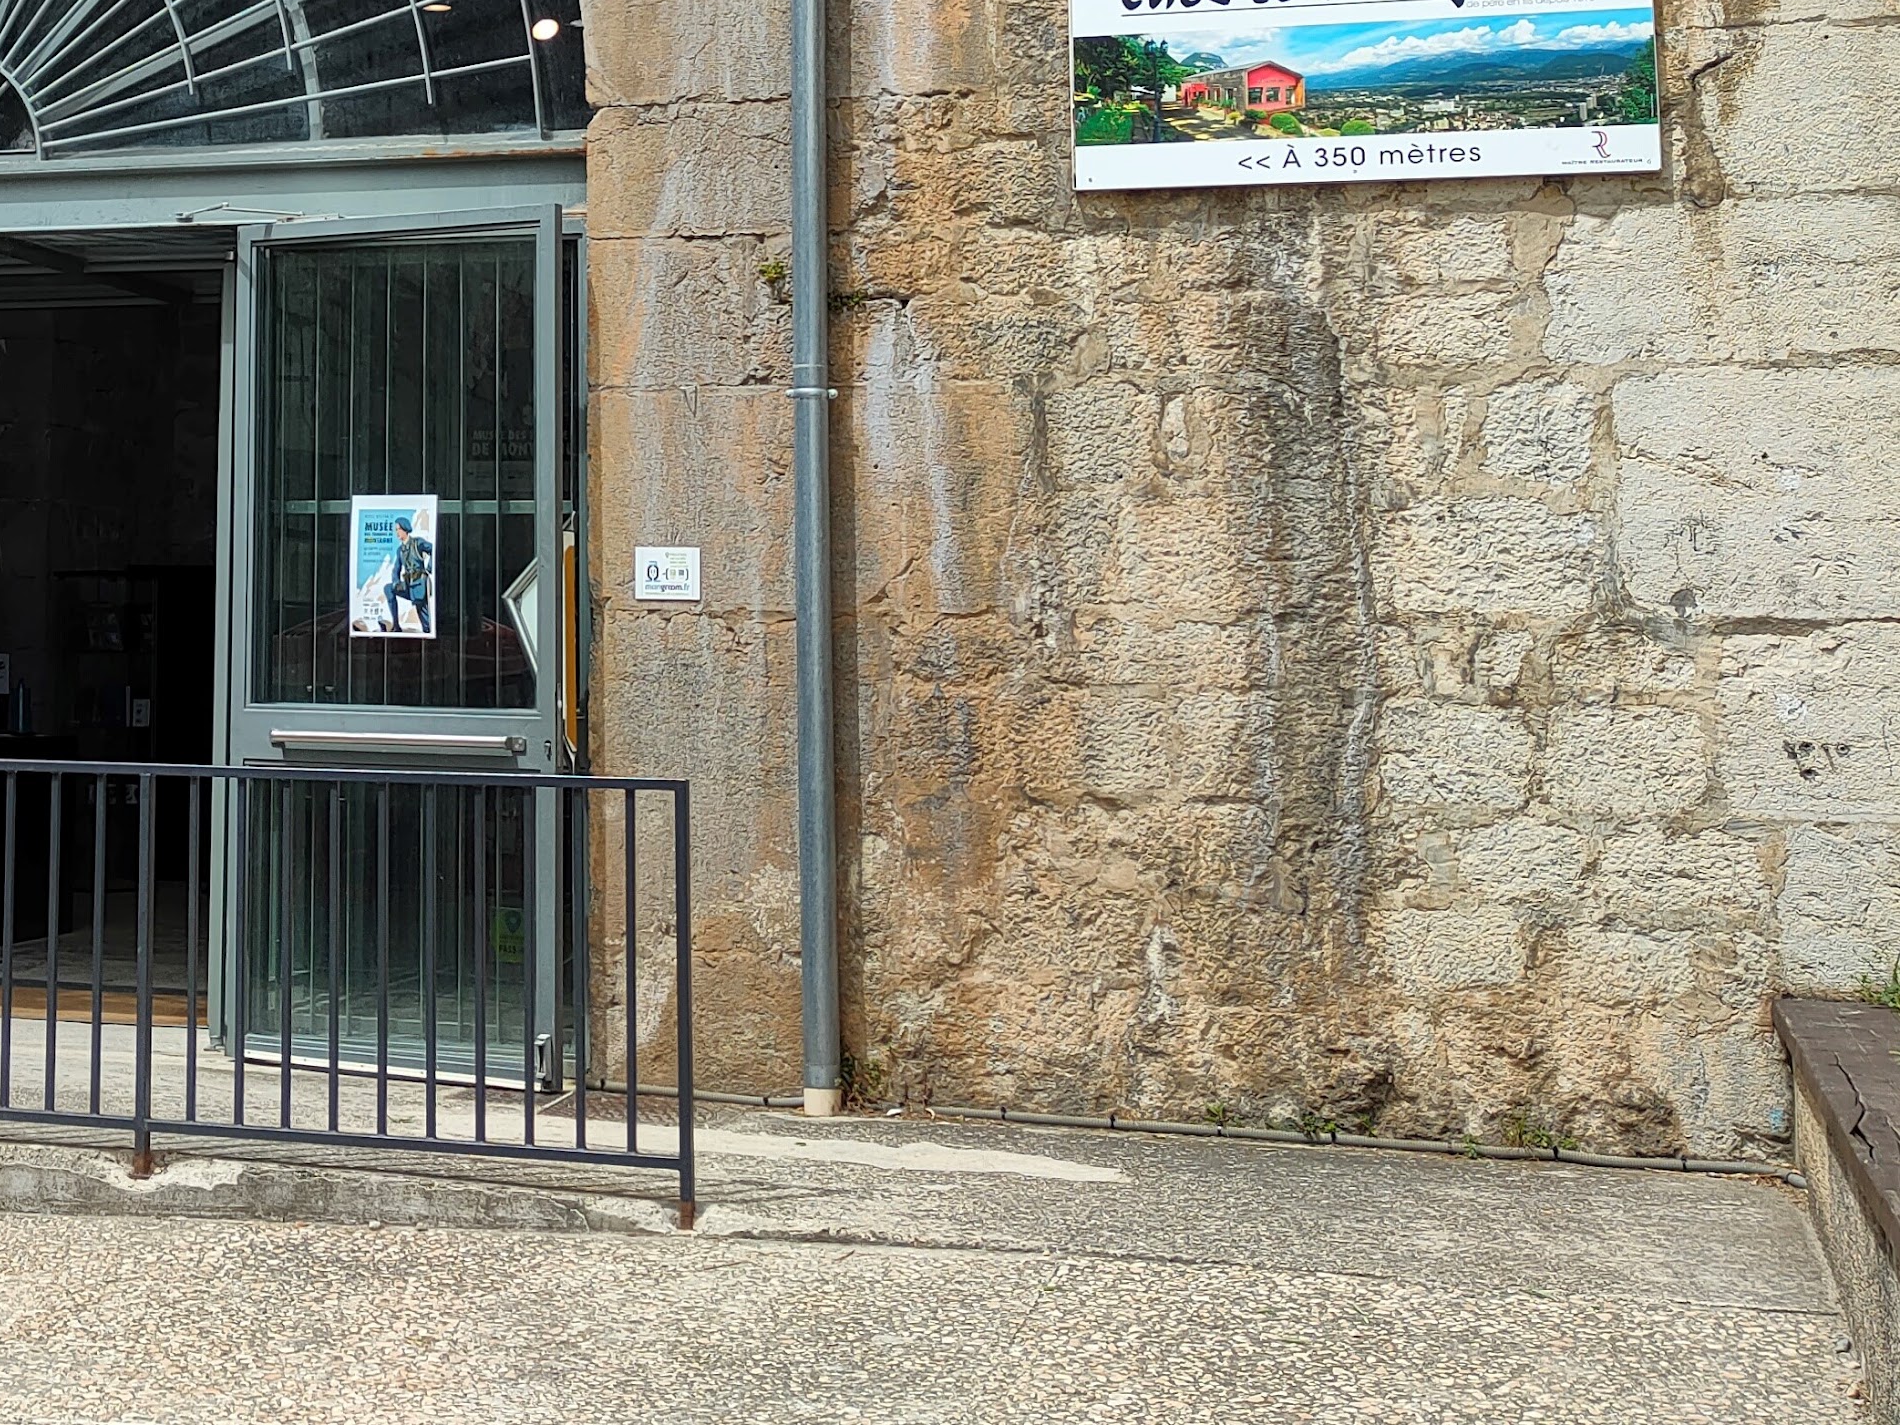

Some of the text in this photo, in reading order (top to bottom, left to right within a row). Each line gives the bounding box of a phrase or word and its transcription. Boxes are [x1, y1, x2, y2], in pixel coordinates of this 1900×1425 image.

[1466, 0, 1478, 9] de
[1282, 143, 1302, 169] À
[1314, 145, 1366, 168] 350
[1379, 142, 1482, 166] mètres
[364, 520, 393, 532] MUSÉE
